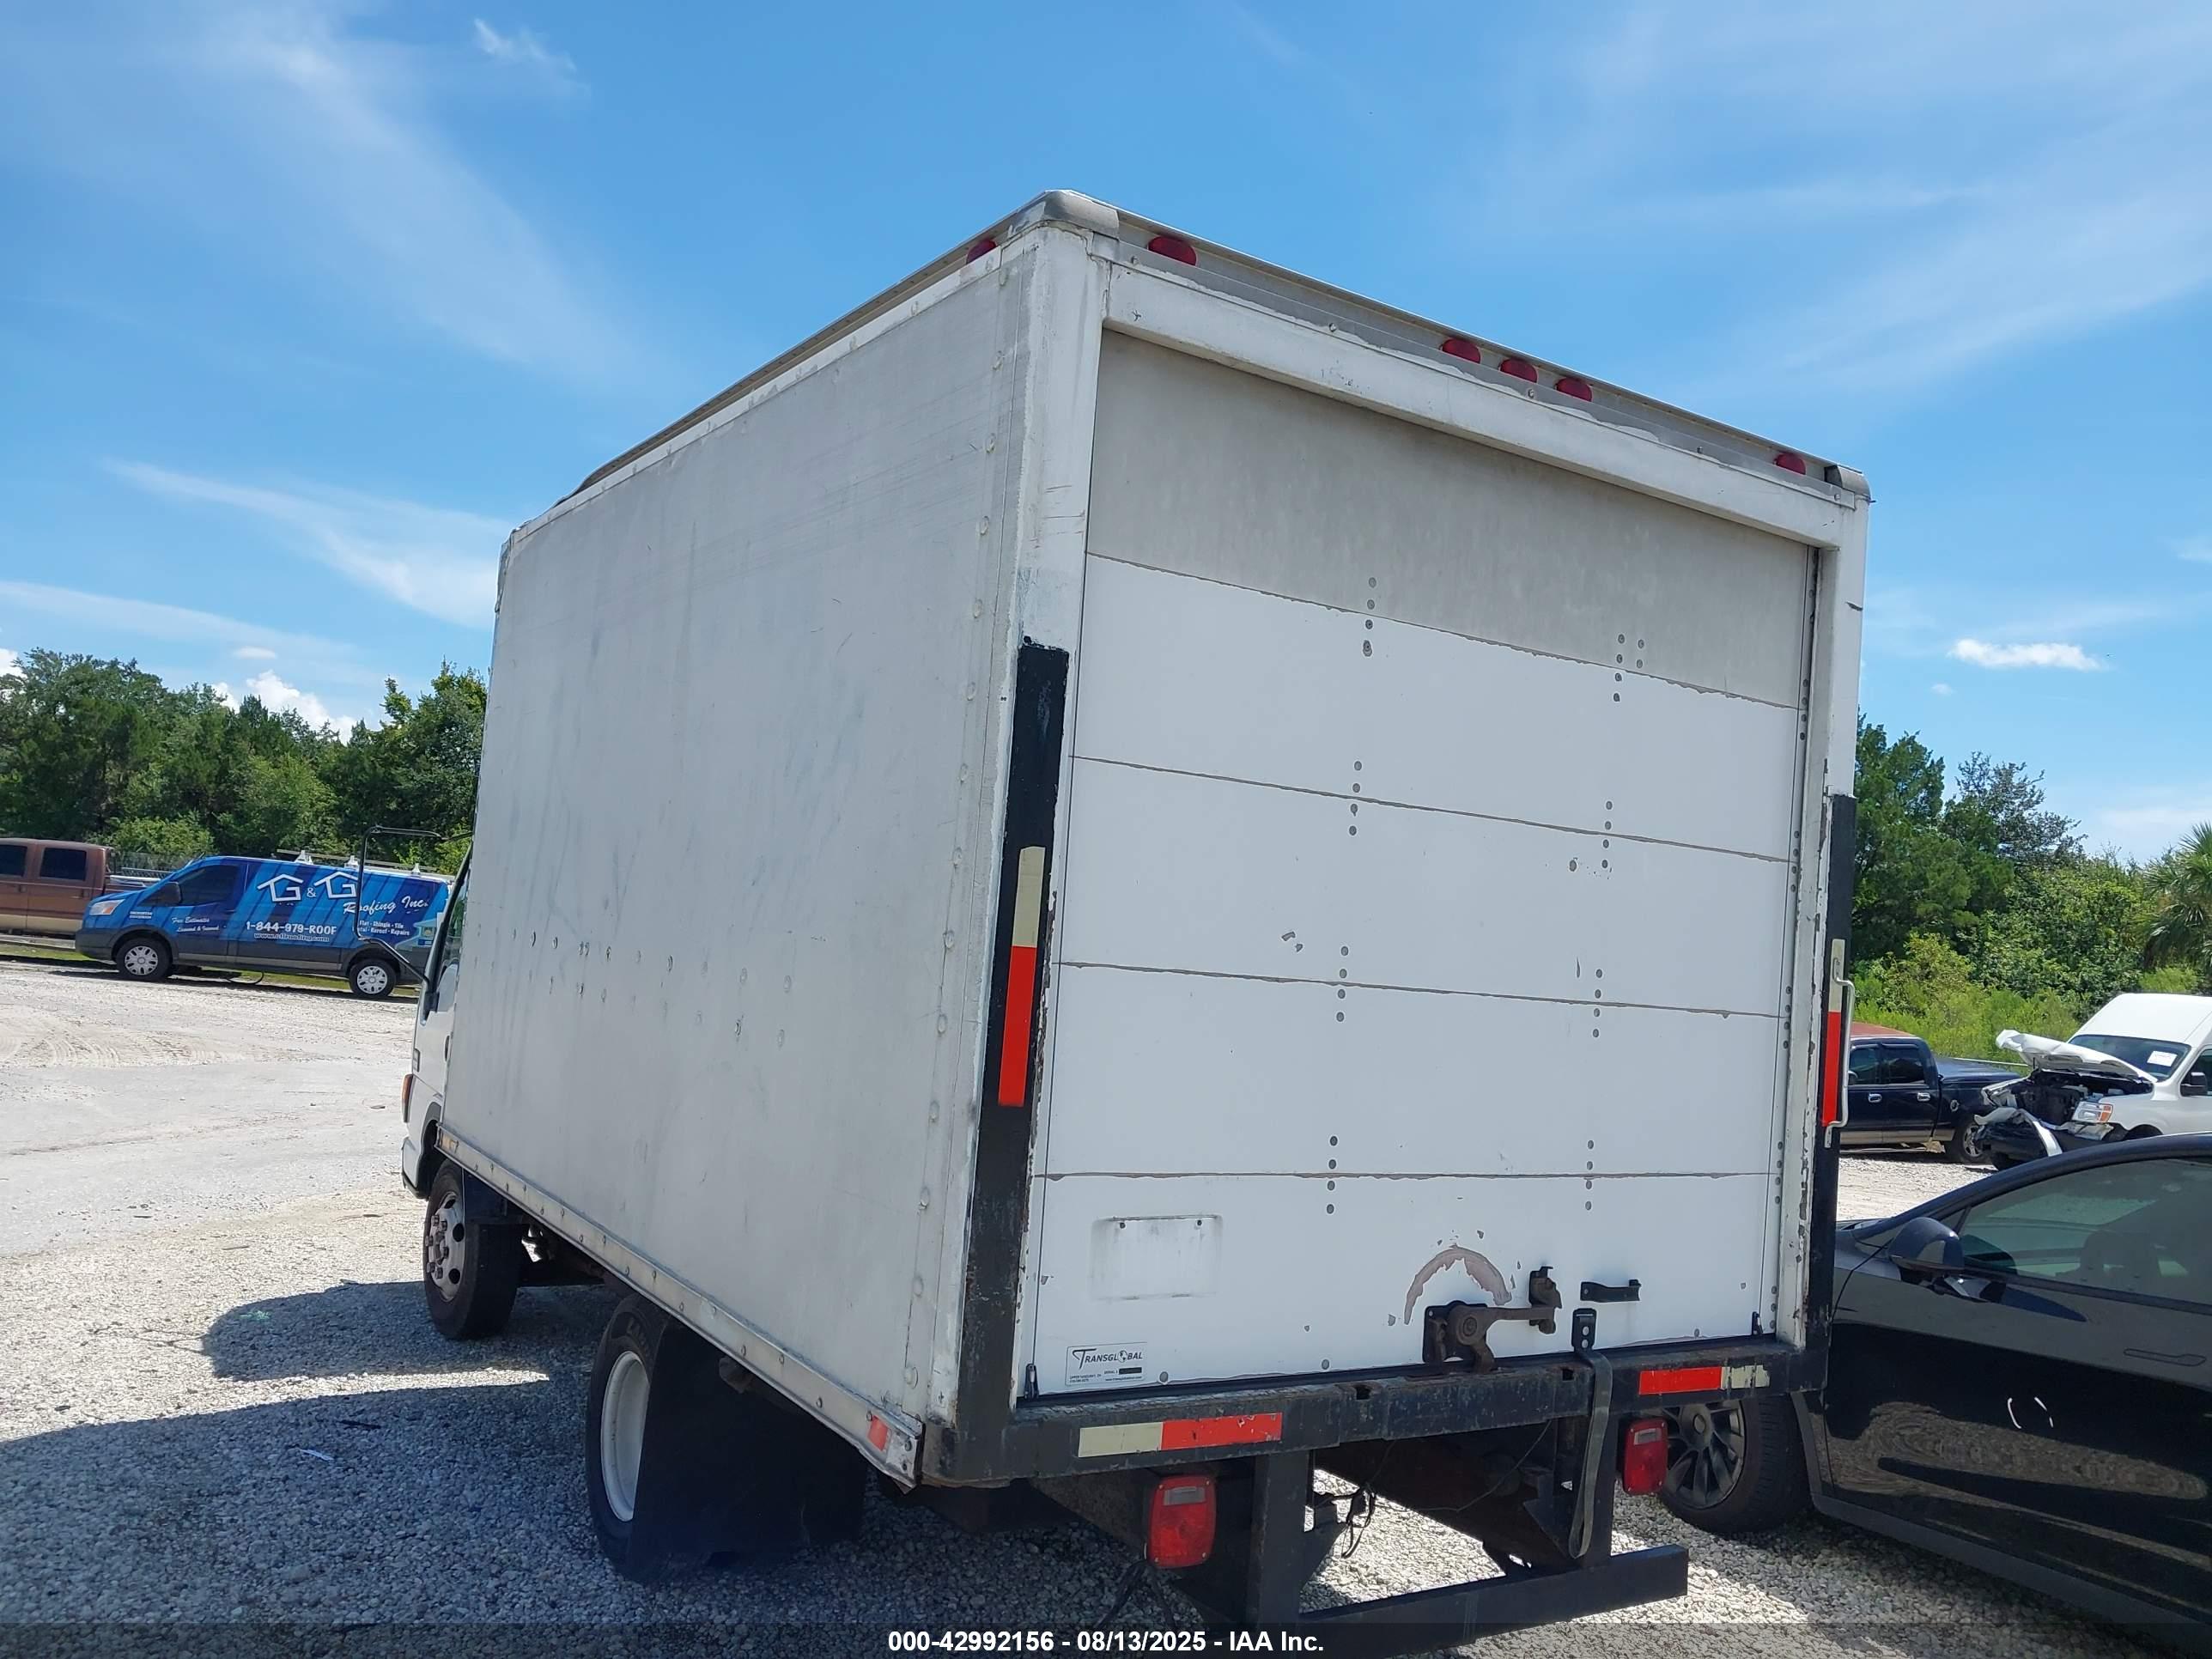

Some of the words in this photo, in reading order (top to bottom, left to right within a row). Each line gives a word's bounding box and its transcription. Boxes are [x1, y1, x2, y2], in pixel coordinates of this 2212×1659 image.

[258, 873, 304, 902] G
[307, 887, 316, 897] &
[314, 871, 358, 898] G
[246, 921, 337, 935] 1-844-979-ROOF
